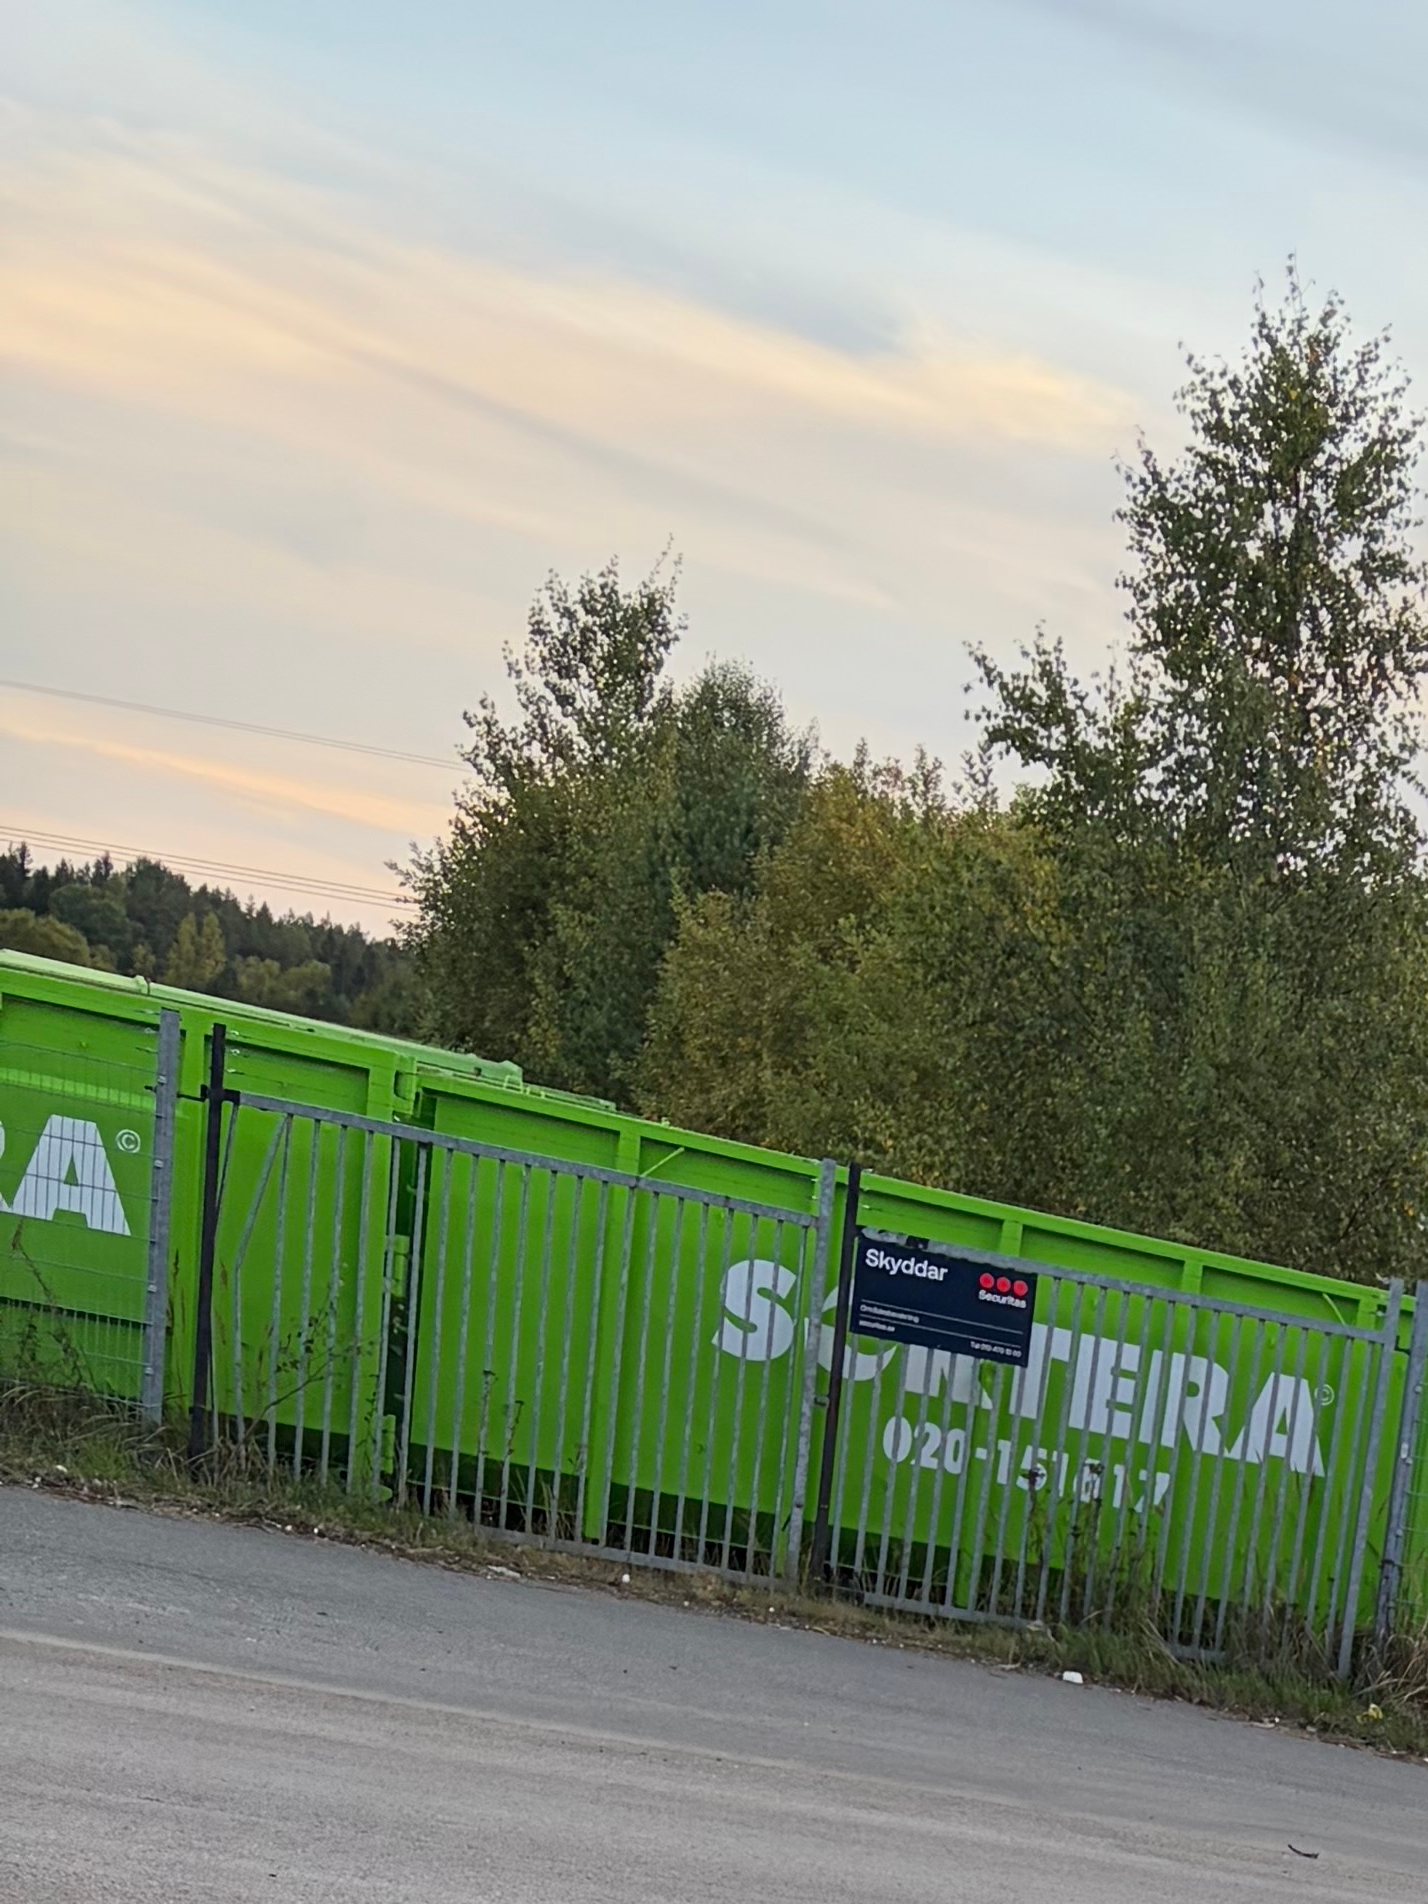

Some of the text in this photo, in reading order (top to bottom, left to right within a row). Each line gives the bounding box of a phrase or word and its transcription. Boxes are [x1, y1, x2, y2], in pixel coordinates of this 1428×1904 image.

[0, 1113, 132, 1236] A
[865, 1248, 948, 1281] Skyddar
[978, 1288, 1027, 1309] Securitas
